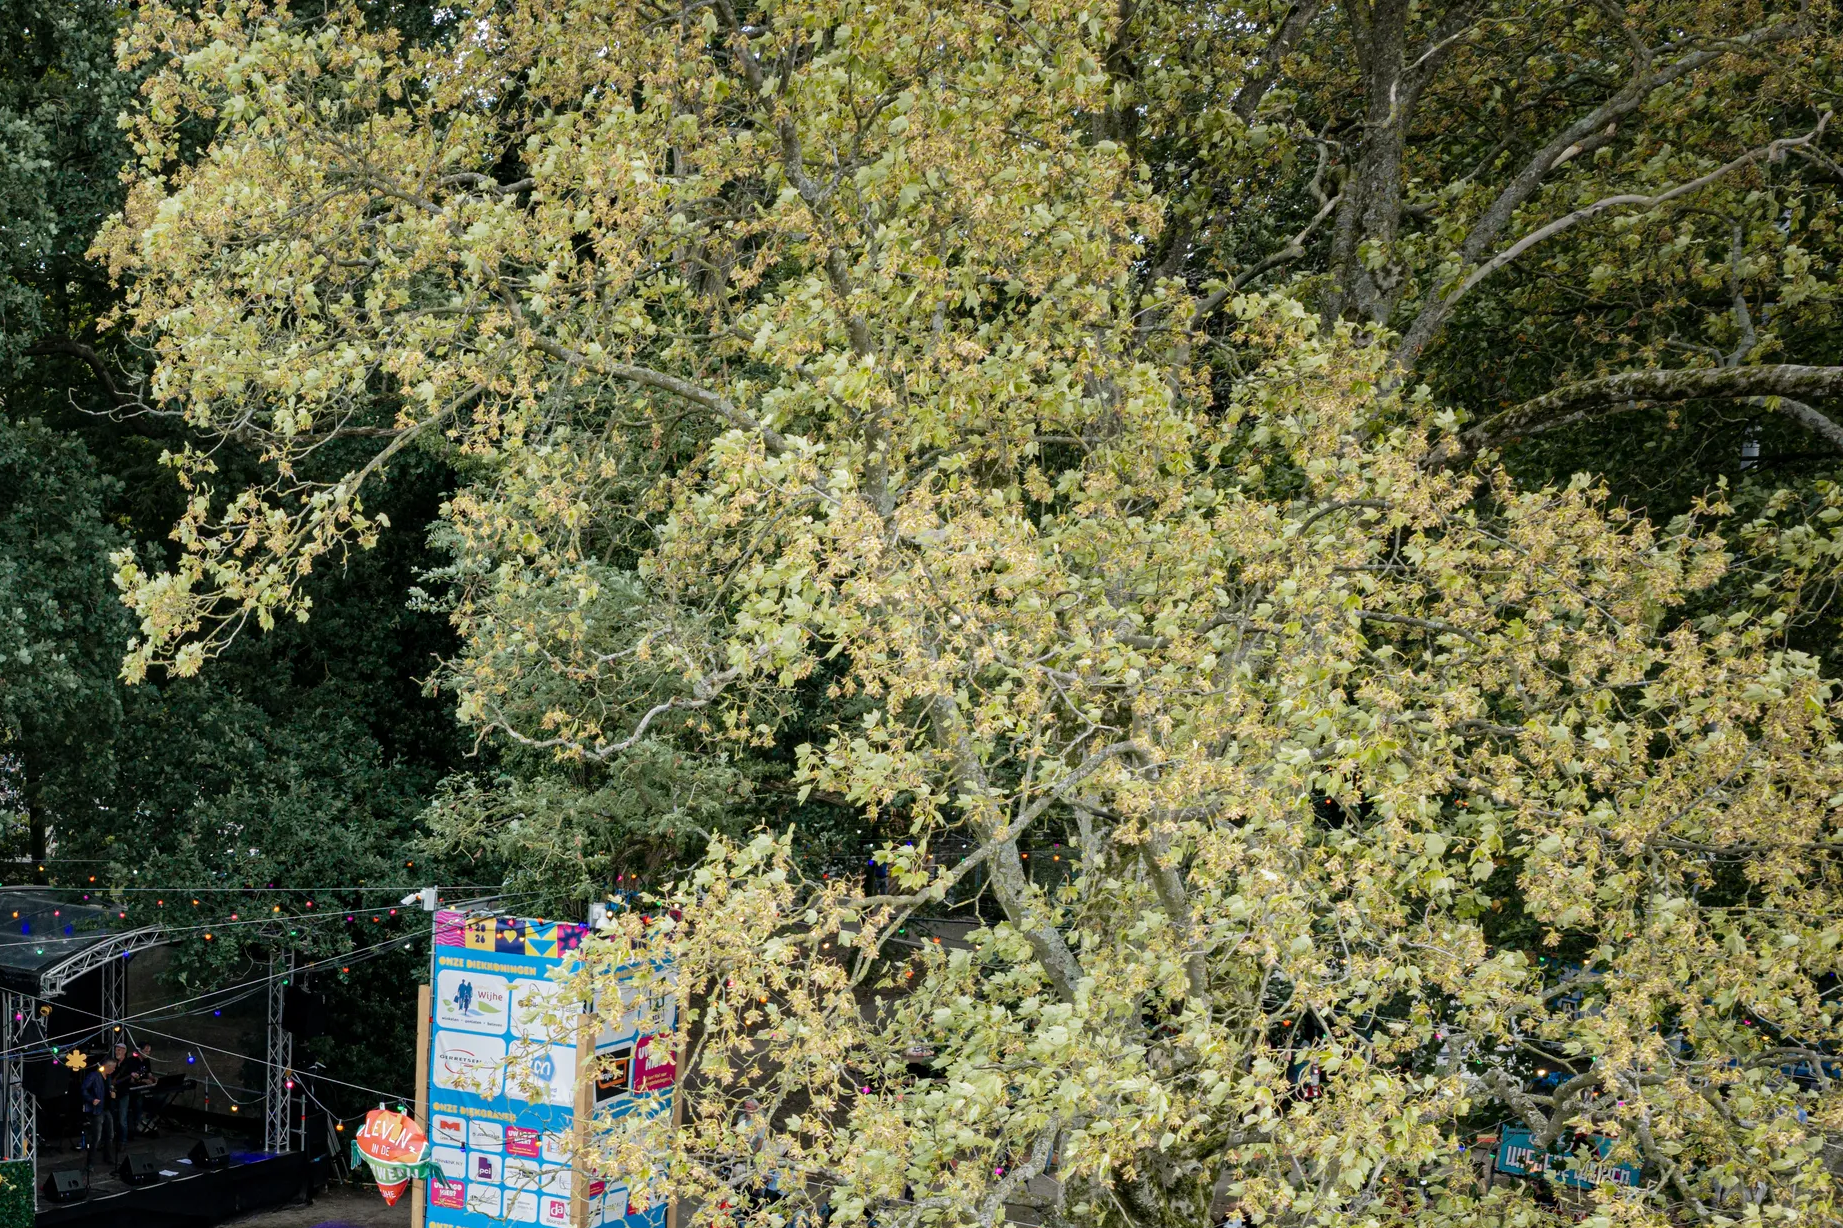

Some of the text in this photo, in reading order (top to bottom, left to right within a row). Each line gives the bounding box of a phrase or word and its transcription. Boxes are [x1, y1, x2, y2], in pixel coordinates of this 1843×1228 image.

[475, 935, 486, 943] 26
[438, 956, 537, 976] ONZE DIEKKONINGEN
[477, 990, 503, 1002] Wijhe
[433, 1102, 457, 1113] ONZE
[371, 1143, 391, 1157] IN DE
